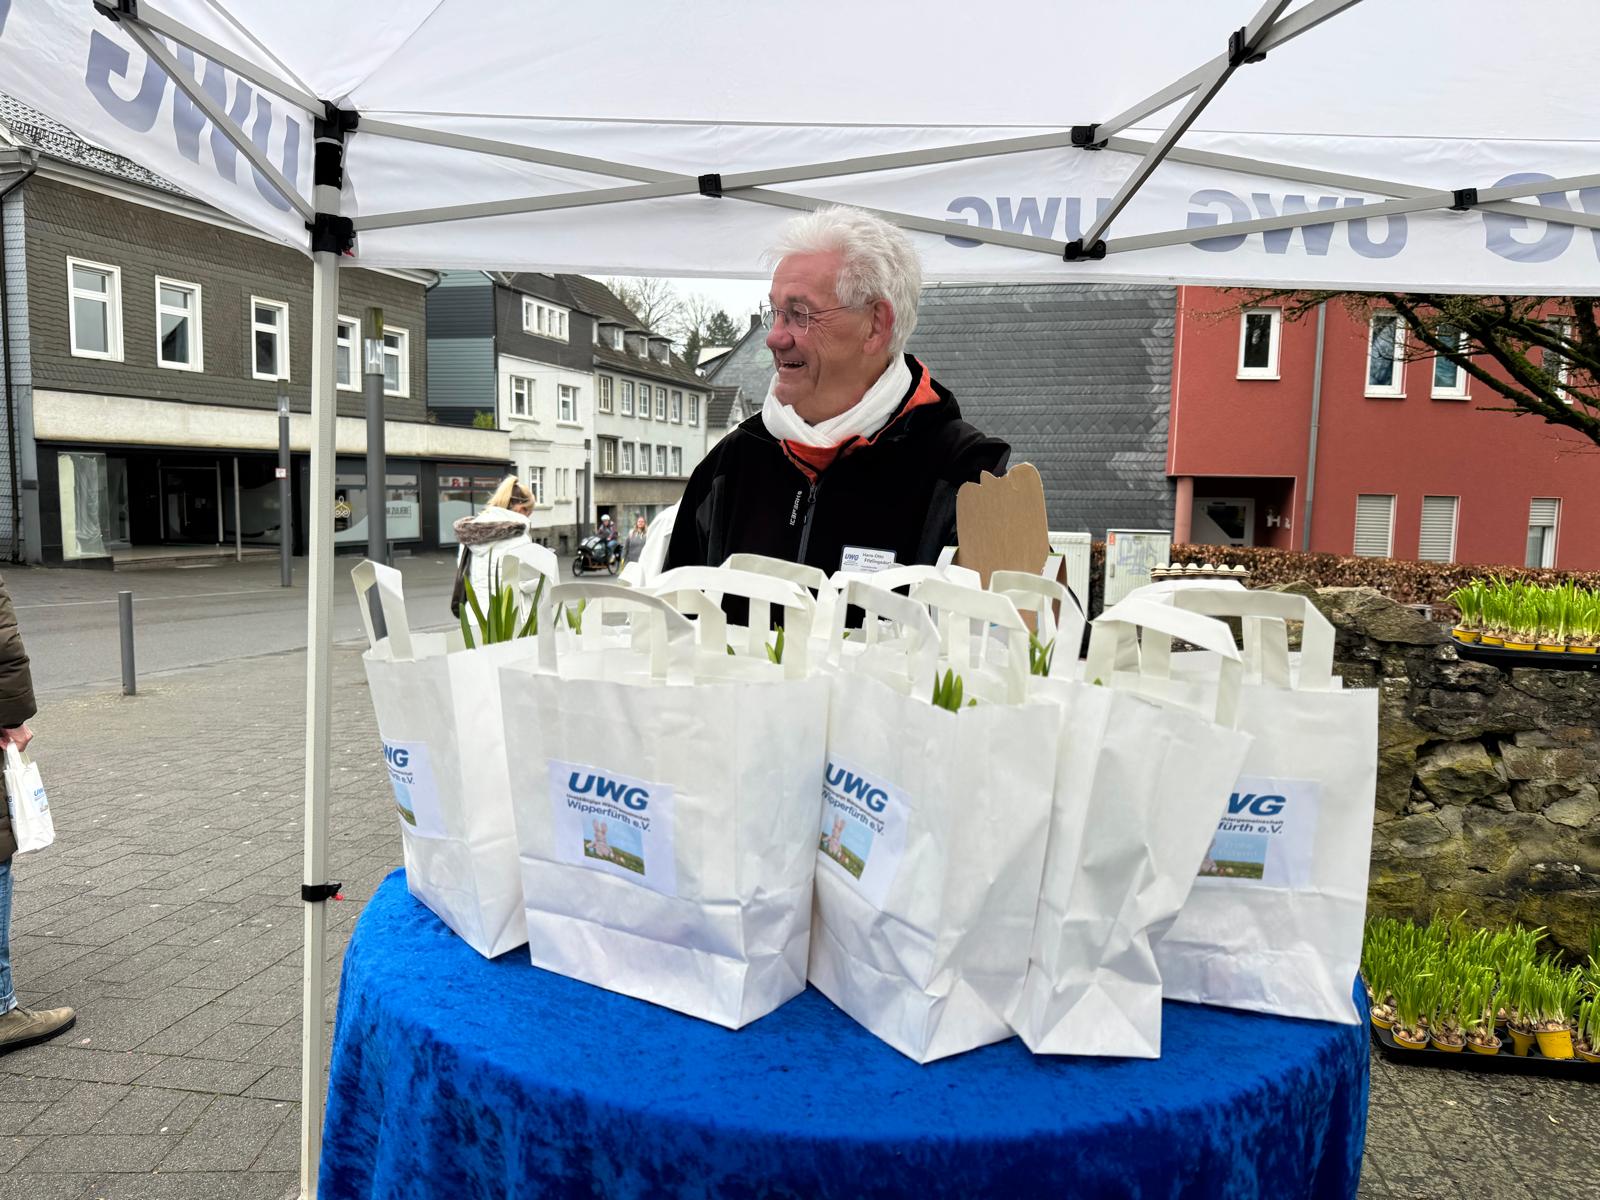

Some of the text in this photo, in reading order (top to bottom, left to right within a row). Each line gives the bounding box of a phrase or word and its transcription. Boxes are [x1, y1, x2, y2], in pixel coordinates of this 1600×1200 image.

[844, 553, 859, 561] UWG
[568, 771, 650, 811] UWG
[826, 762, 889, 813] UWG
[567, 798, 651, 832] Wipperfürth e.V.
[1257, 825, 1283, 834] e.V.
